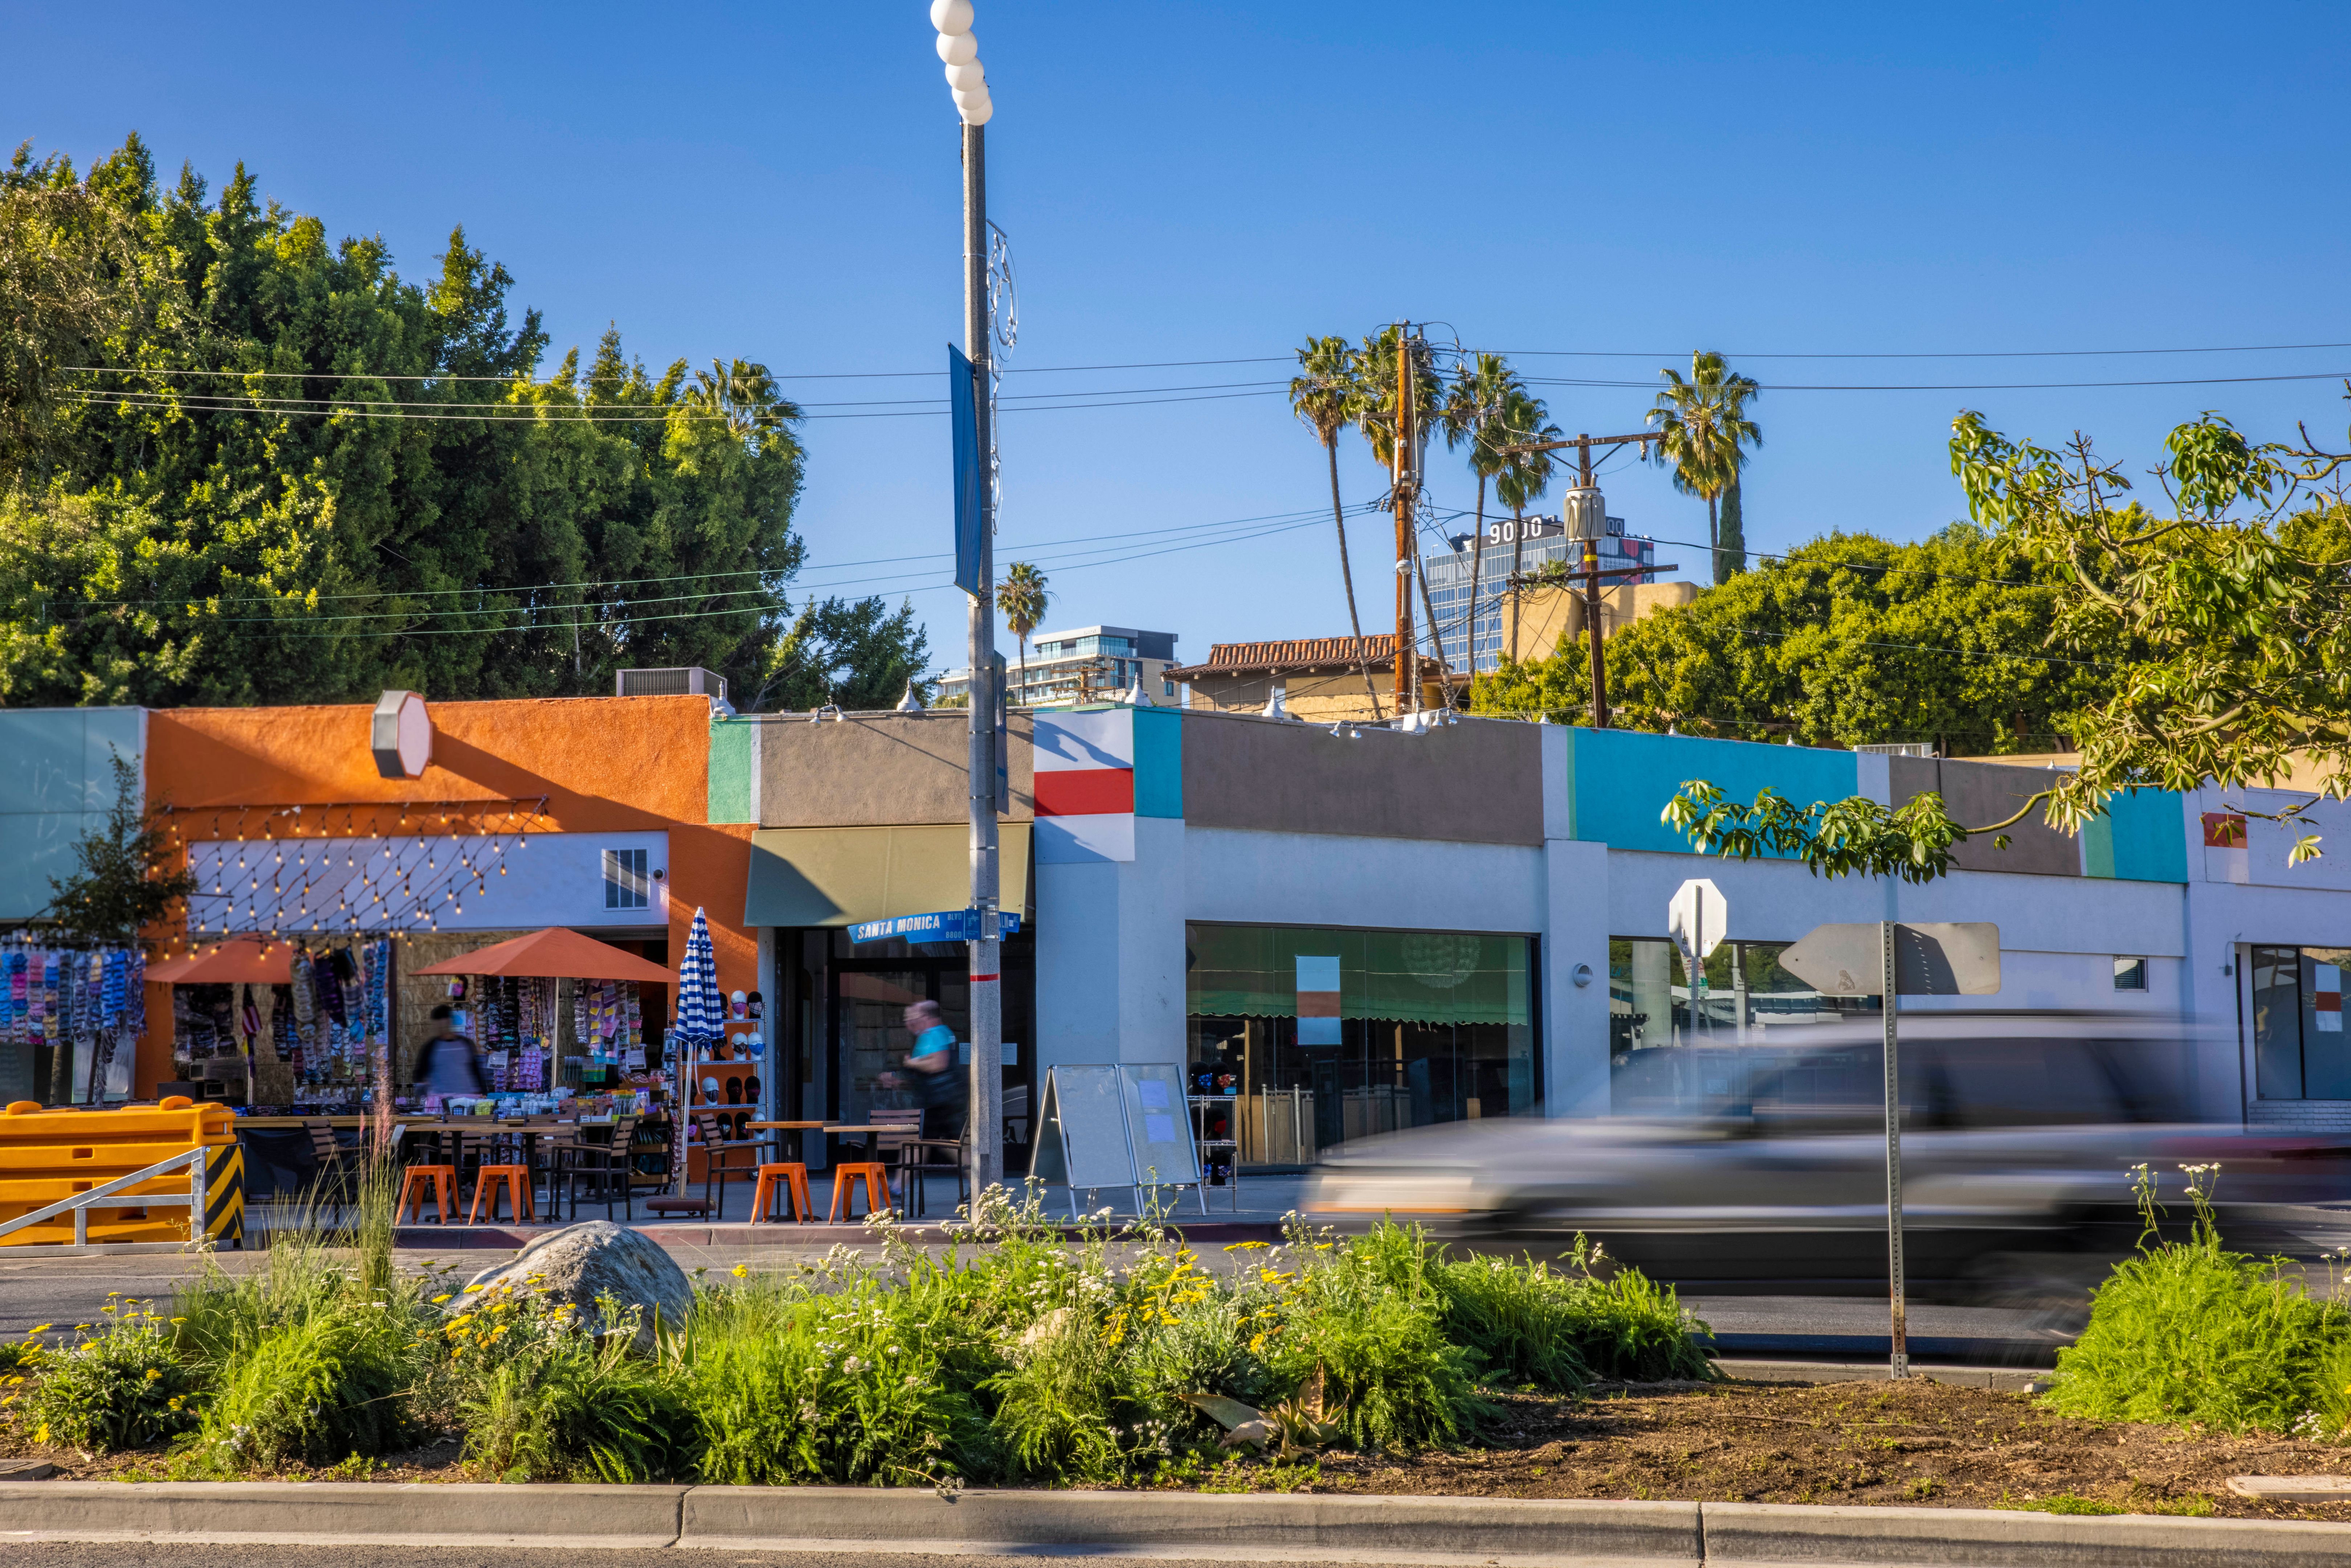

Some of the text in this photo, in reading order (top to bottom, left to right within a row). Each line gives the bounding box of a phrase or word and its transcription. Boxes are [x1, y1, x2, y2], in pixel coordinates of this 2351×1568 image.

[1489, 516, 1543, 544] 9000
[857, 915, 940, 940] SANTA MONICA
